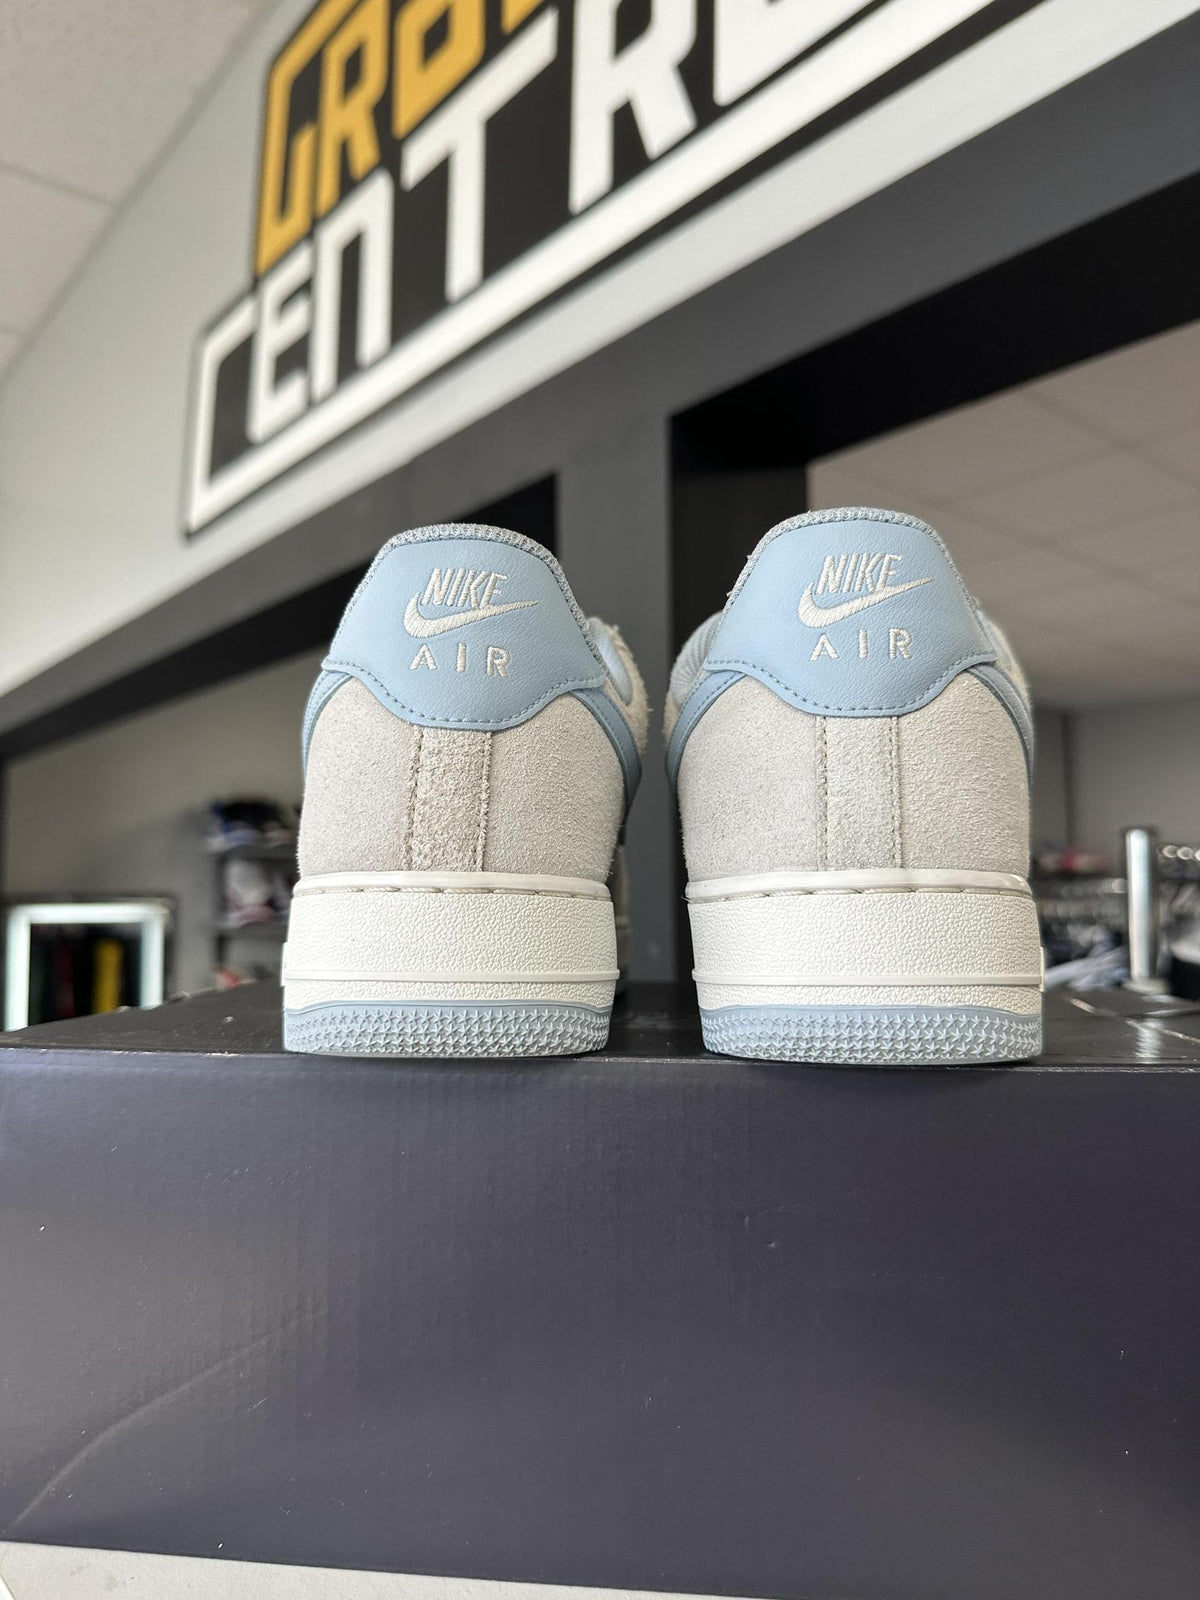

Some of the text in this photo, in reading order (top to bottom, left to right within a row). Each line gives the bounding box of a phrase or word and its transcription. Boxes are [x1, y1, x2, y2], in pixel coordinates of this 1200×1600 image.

[421, 567, 509, 610] NIKE
[815, 552, 902, 594] NIKE
[409, 642, 511, 678] AIR
[810, 627, 913, 662] AIR
